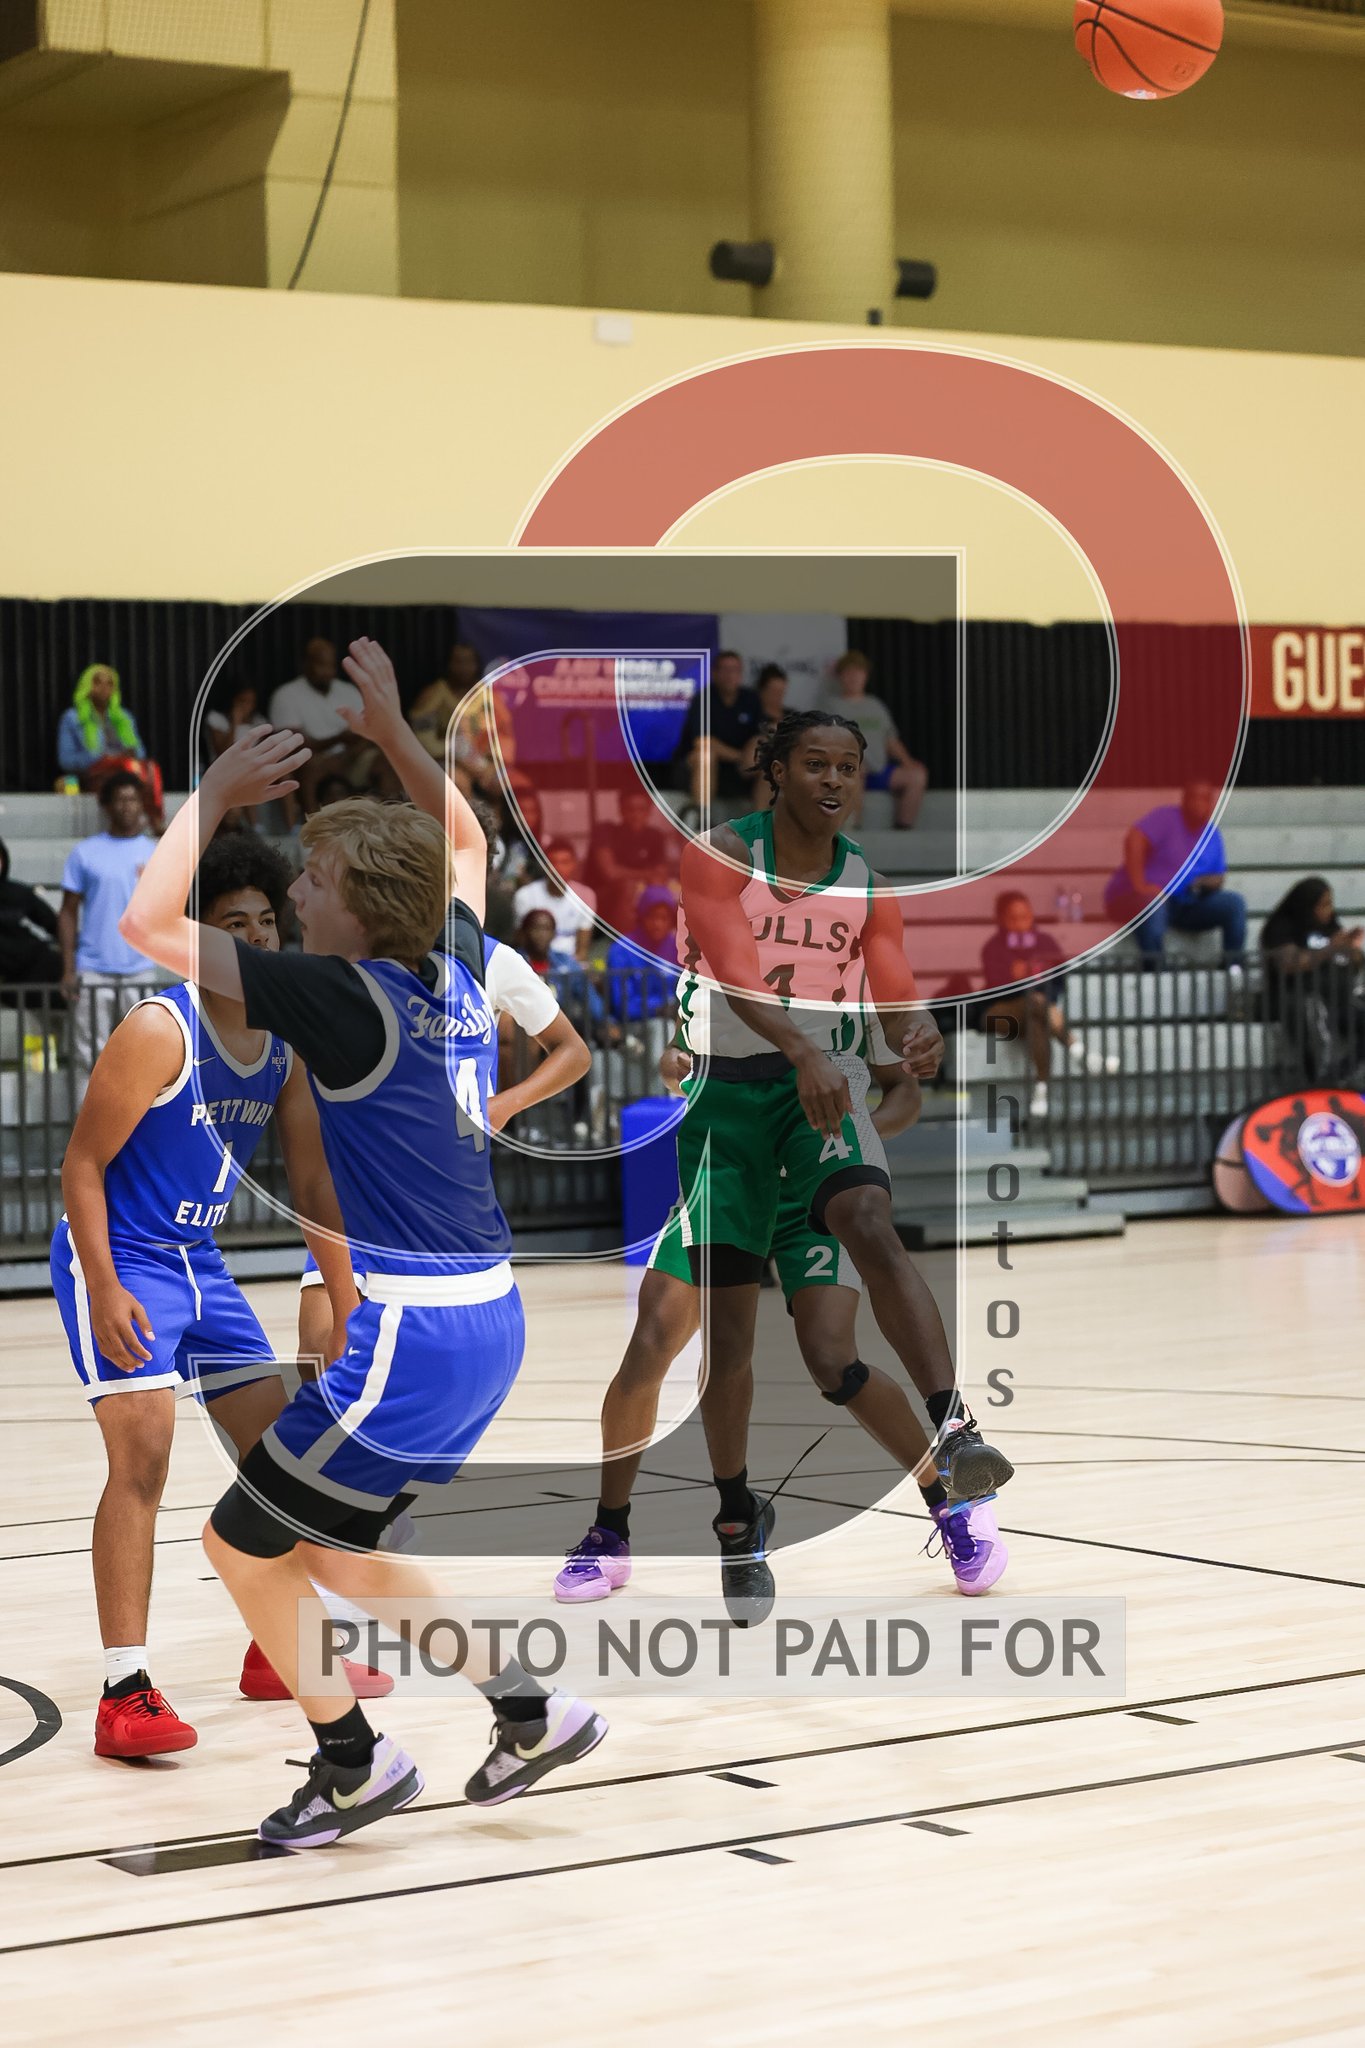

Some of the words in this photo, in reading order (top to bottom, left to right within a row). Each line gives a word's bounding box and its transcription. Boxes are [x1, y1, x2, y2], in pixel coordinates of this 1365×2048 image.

[1272, 631, 1365, 711] GUE
[749, 915, 849, 953] ULLS
[763, 963, 797, 1012] 4
[406, 993, 493, 1046] Family
[190, 1098, 275, 1127] PETTWAY
[456, 1057, 486, 1153] 4
[212, 1140, 234, 1193] 1
[818, 1132, 854, 1165] 4
[804, 1245, 834, 1278] 2
